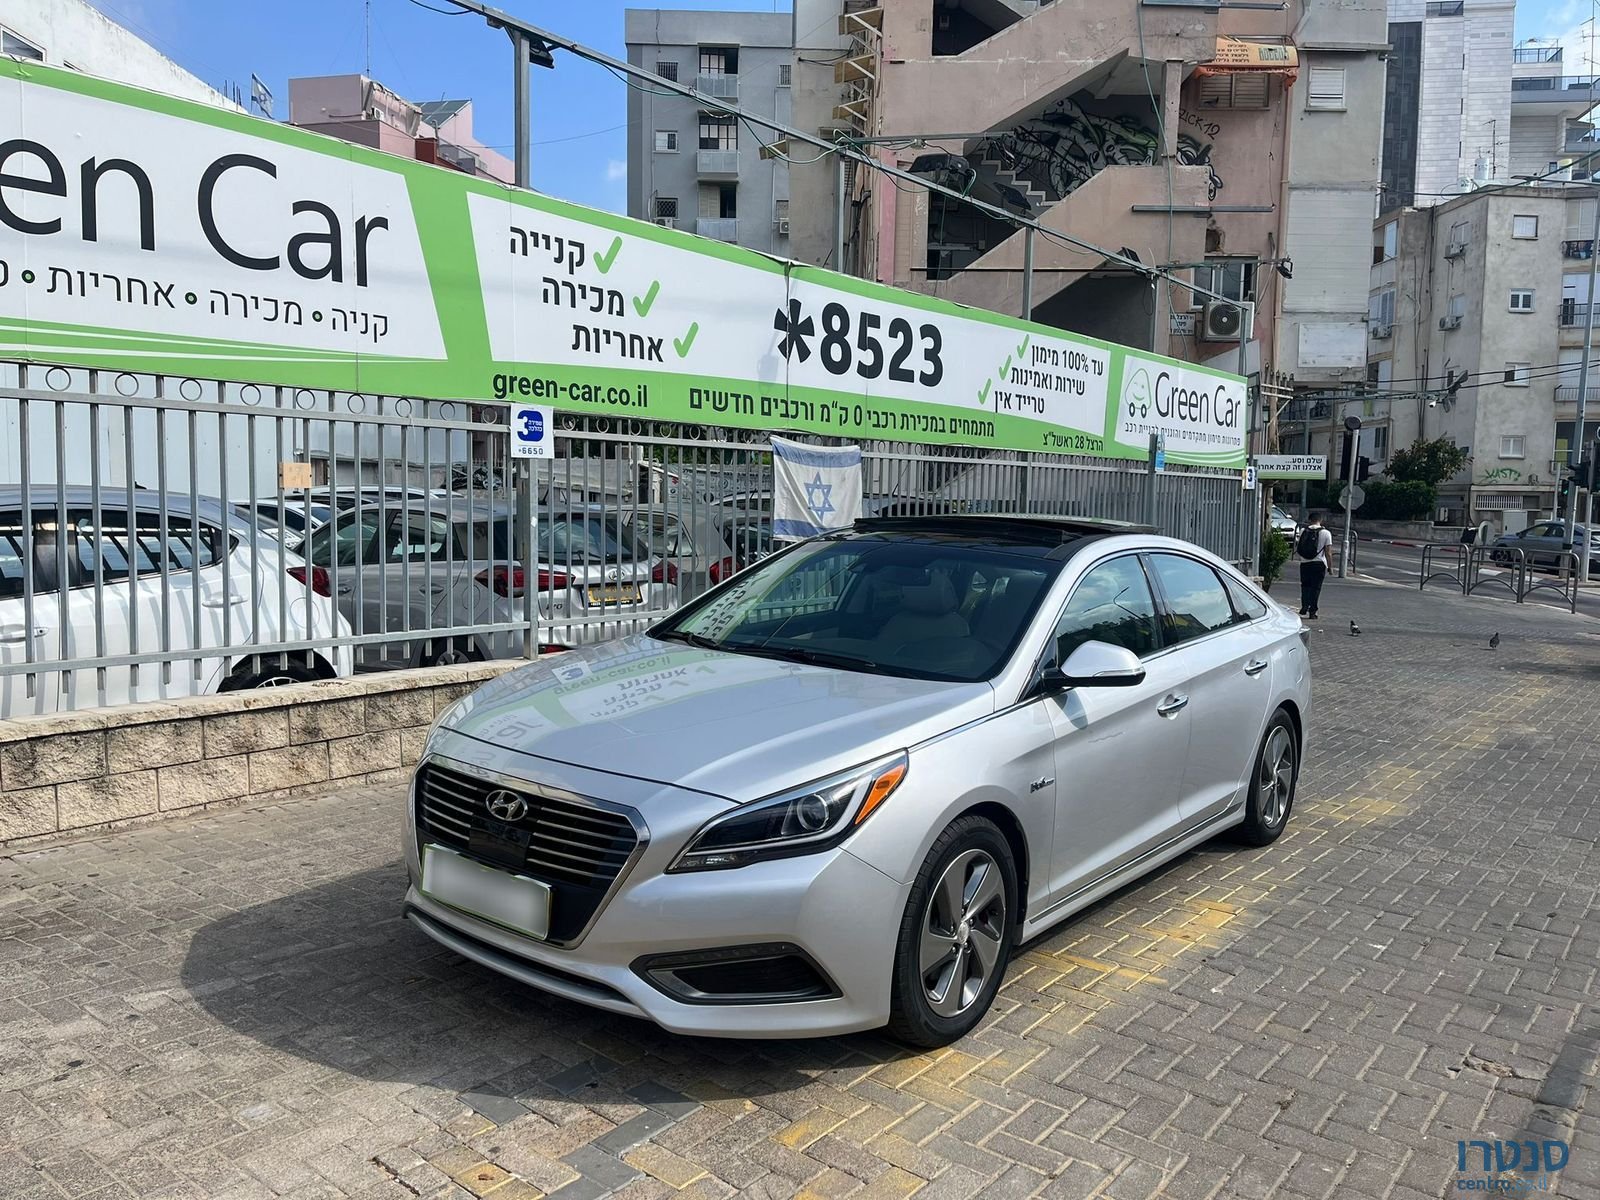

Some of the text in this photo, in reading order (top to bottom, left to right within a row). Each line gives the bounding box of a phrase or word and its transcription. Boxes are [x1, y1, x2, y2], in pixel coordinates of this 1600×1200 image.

[198, 153, 389, 288] Car
[510, 226, 585, 275] קנייה
[46, 266, 175, 309] אחריות
[542, 276, 625, 317] מכירה
[210, 289, 303, 326] מכירה
[331, 308, 389, 344] קניה
[572, 324, 664, 362] אחריות
[1032, 345, 1104, 376] עד 100% מימון
[492, 373, 648, 408] green-car.co.il
[1011, 367, 1085, 396] שירות ואמינות
[689, 388, 754, 415] חדשים
[760, 396, 814, 421] ורכבים
[995, 391, 1045, 413] טרייד אין
[1155, 371, 1241, 429] Green Car
[853, 405, 863, 427] 0
[867, 410, 897, 430] רכבי
[900, 413, 946, 433] במכירת
[949, 417, 995, 437] מתמחים
[1075, 435, 1085, 449] 28
[1085, 436, 1104, 451] הרצל
[1276, 464, 1291, 472] קצת
